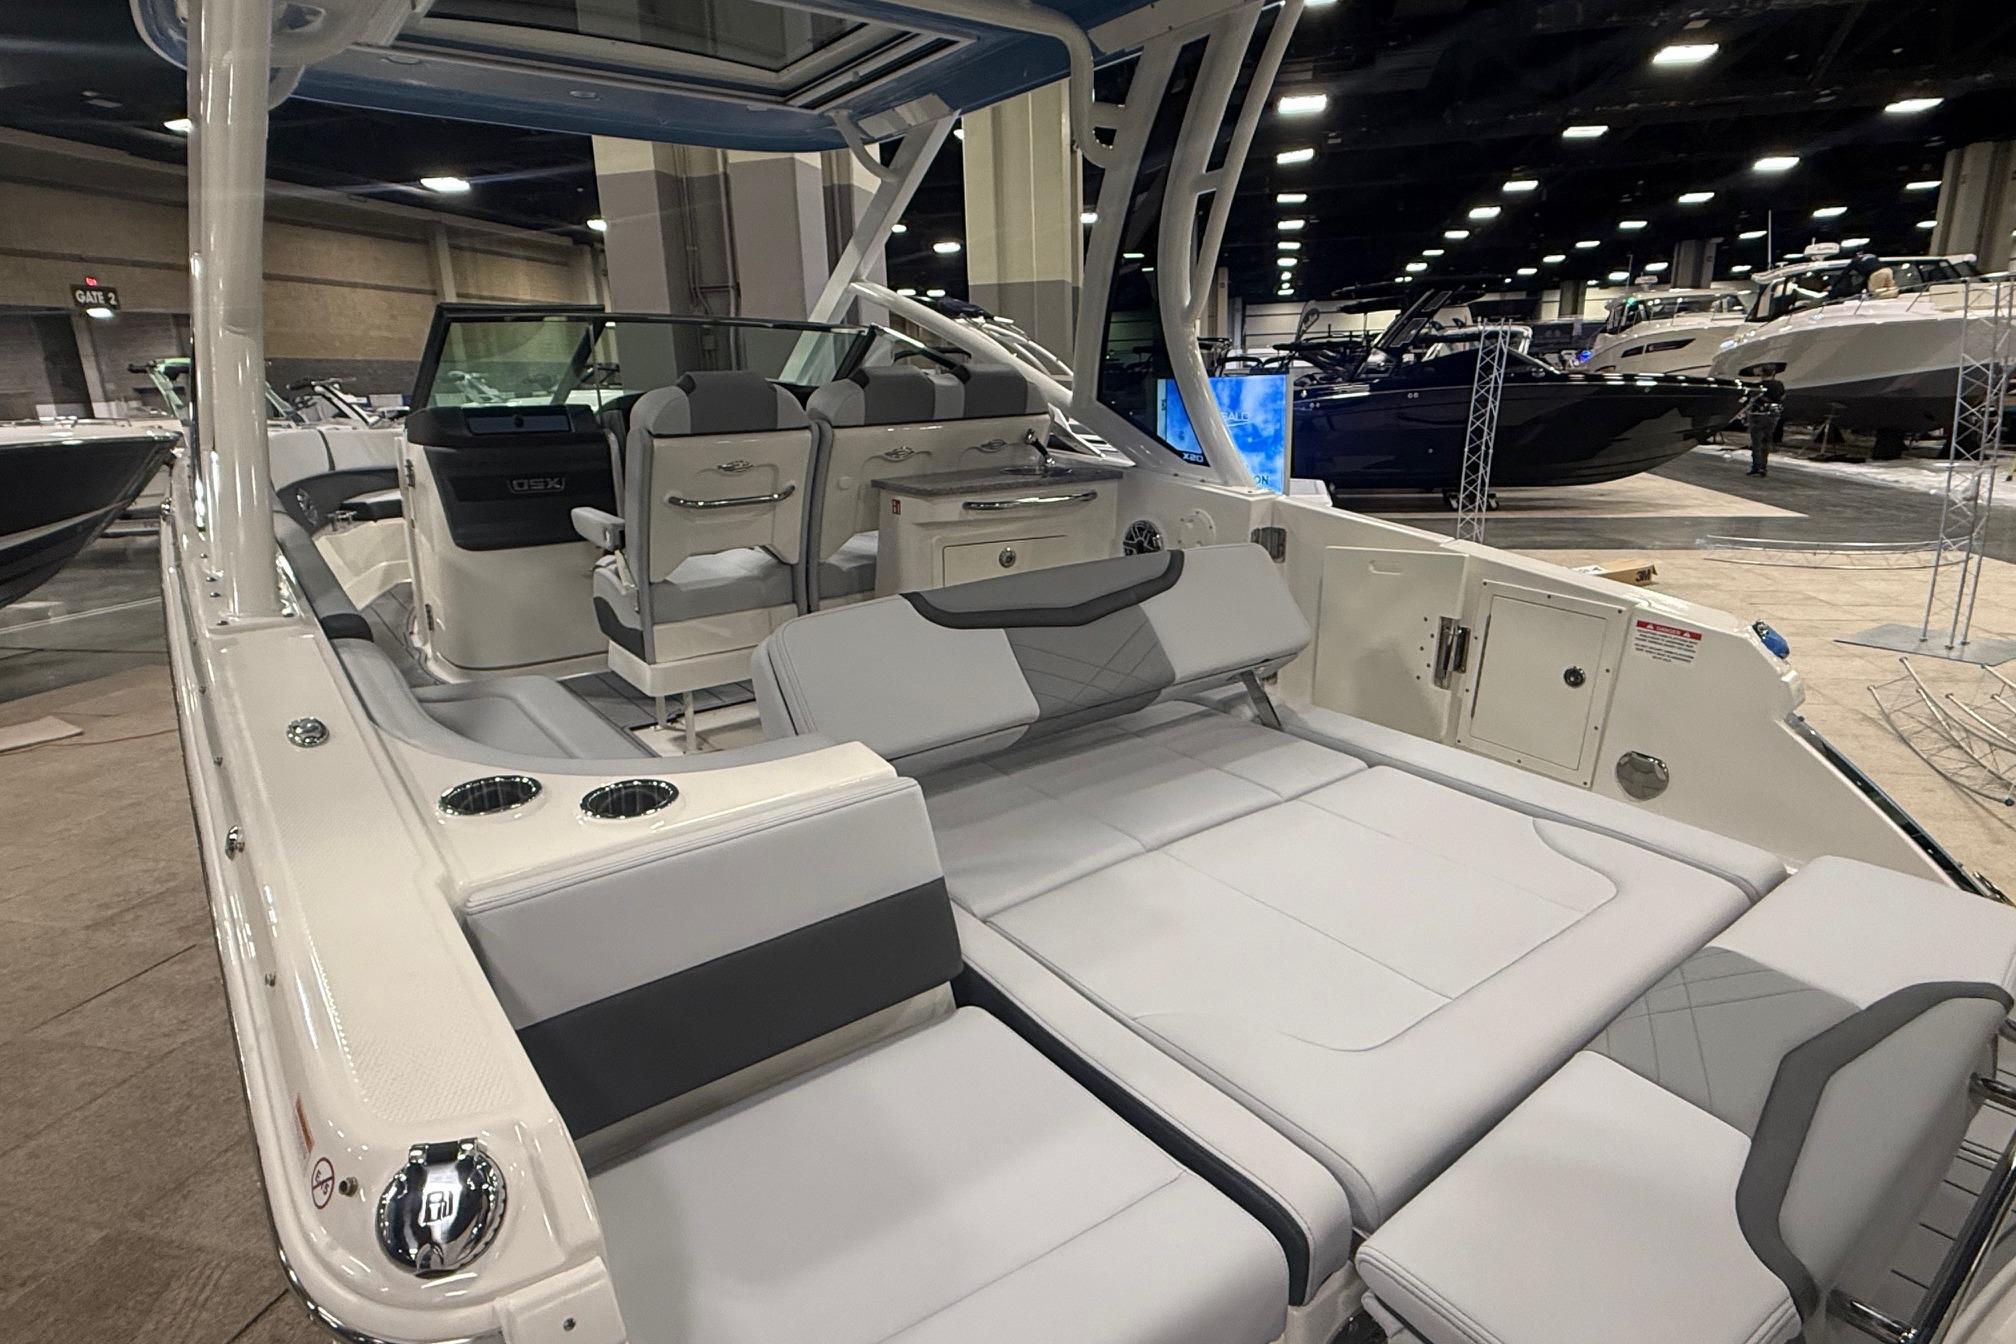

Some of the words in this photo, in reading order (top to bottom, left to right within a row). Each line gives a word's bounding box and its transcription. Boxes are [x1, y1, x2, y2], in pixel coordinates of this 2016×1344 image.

[75, 289, 105, 304] GATE
[107, 292, 117, 305] 2
[512, 478, 561, 491] OSX
[1636, 569, 1651, 582] 3M
[1656, 625, 1681, 635] DANGER
